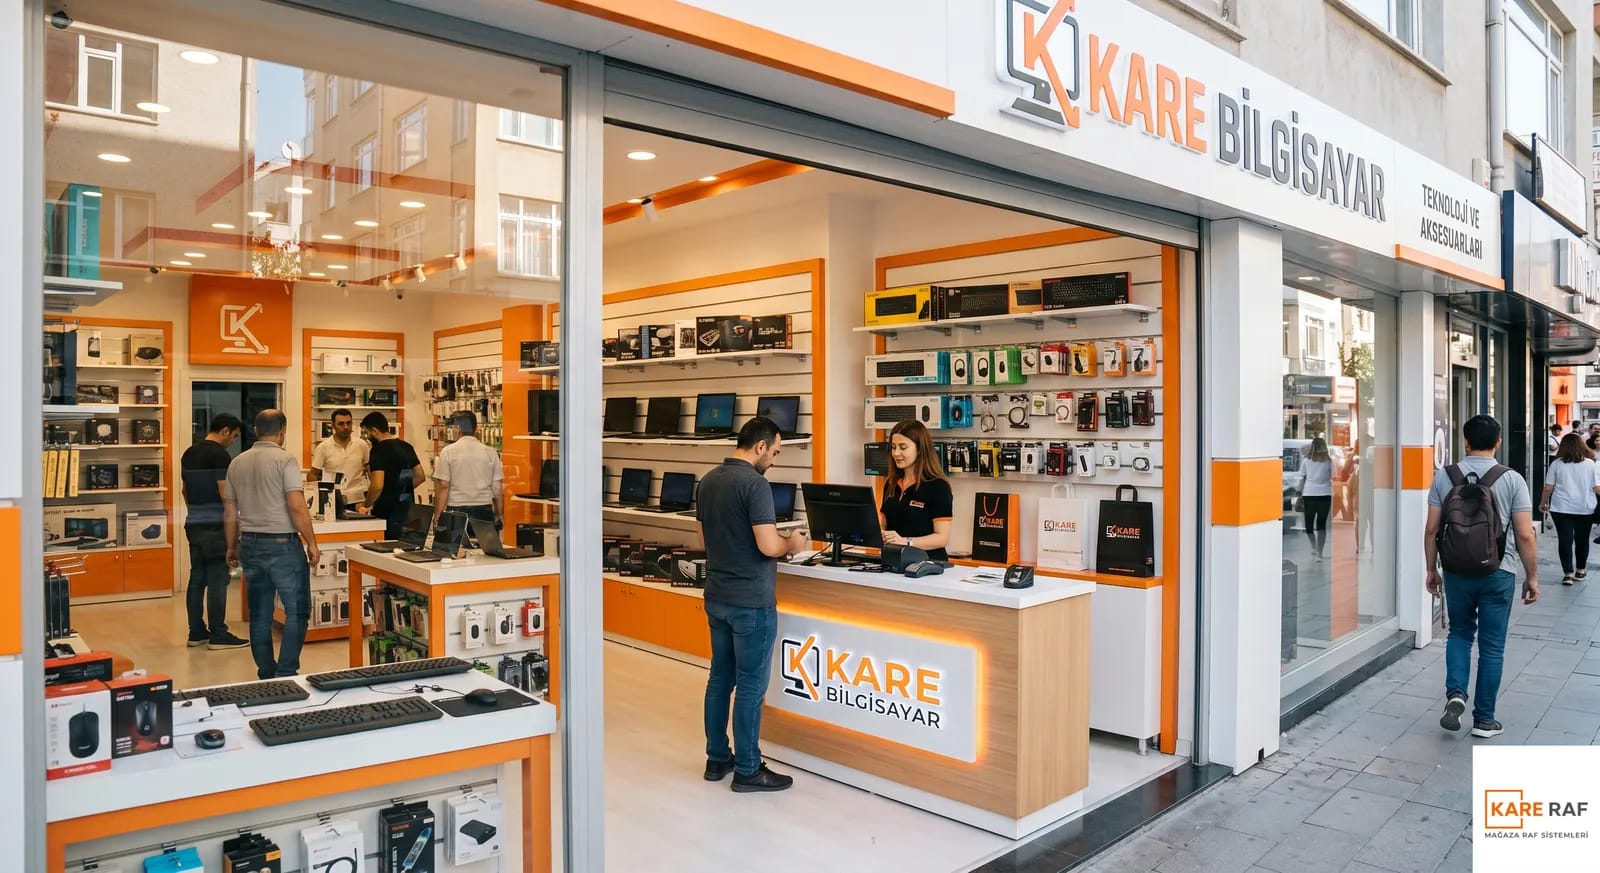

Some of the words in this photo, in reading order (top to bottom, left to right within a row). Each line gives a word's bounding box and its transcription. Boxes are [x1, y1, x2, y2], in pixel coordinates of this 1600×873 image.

[1089, 33, 1207, 154] KARE
[1219, 87, 1387, 222] BİLGİSAYAR
[1422, 184, 1467, 224] TEKNOLOJİ
[1470, 207, 1480, 229] VE
[1420, 217, 1482, 259] AKSESUARLARI
[1055, 521, 1076, 529] KARE
[1117, 527, 1140, 535] KARE
[826, 649, 941, 706] KARE
[826, 685, 941, 729] BİLGİSAYAR
